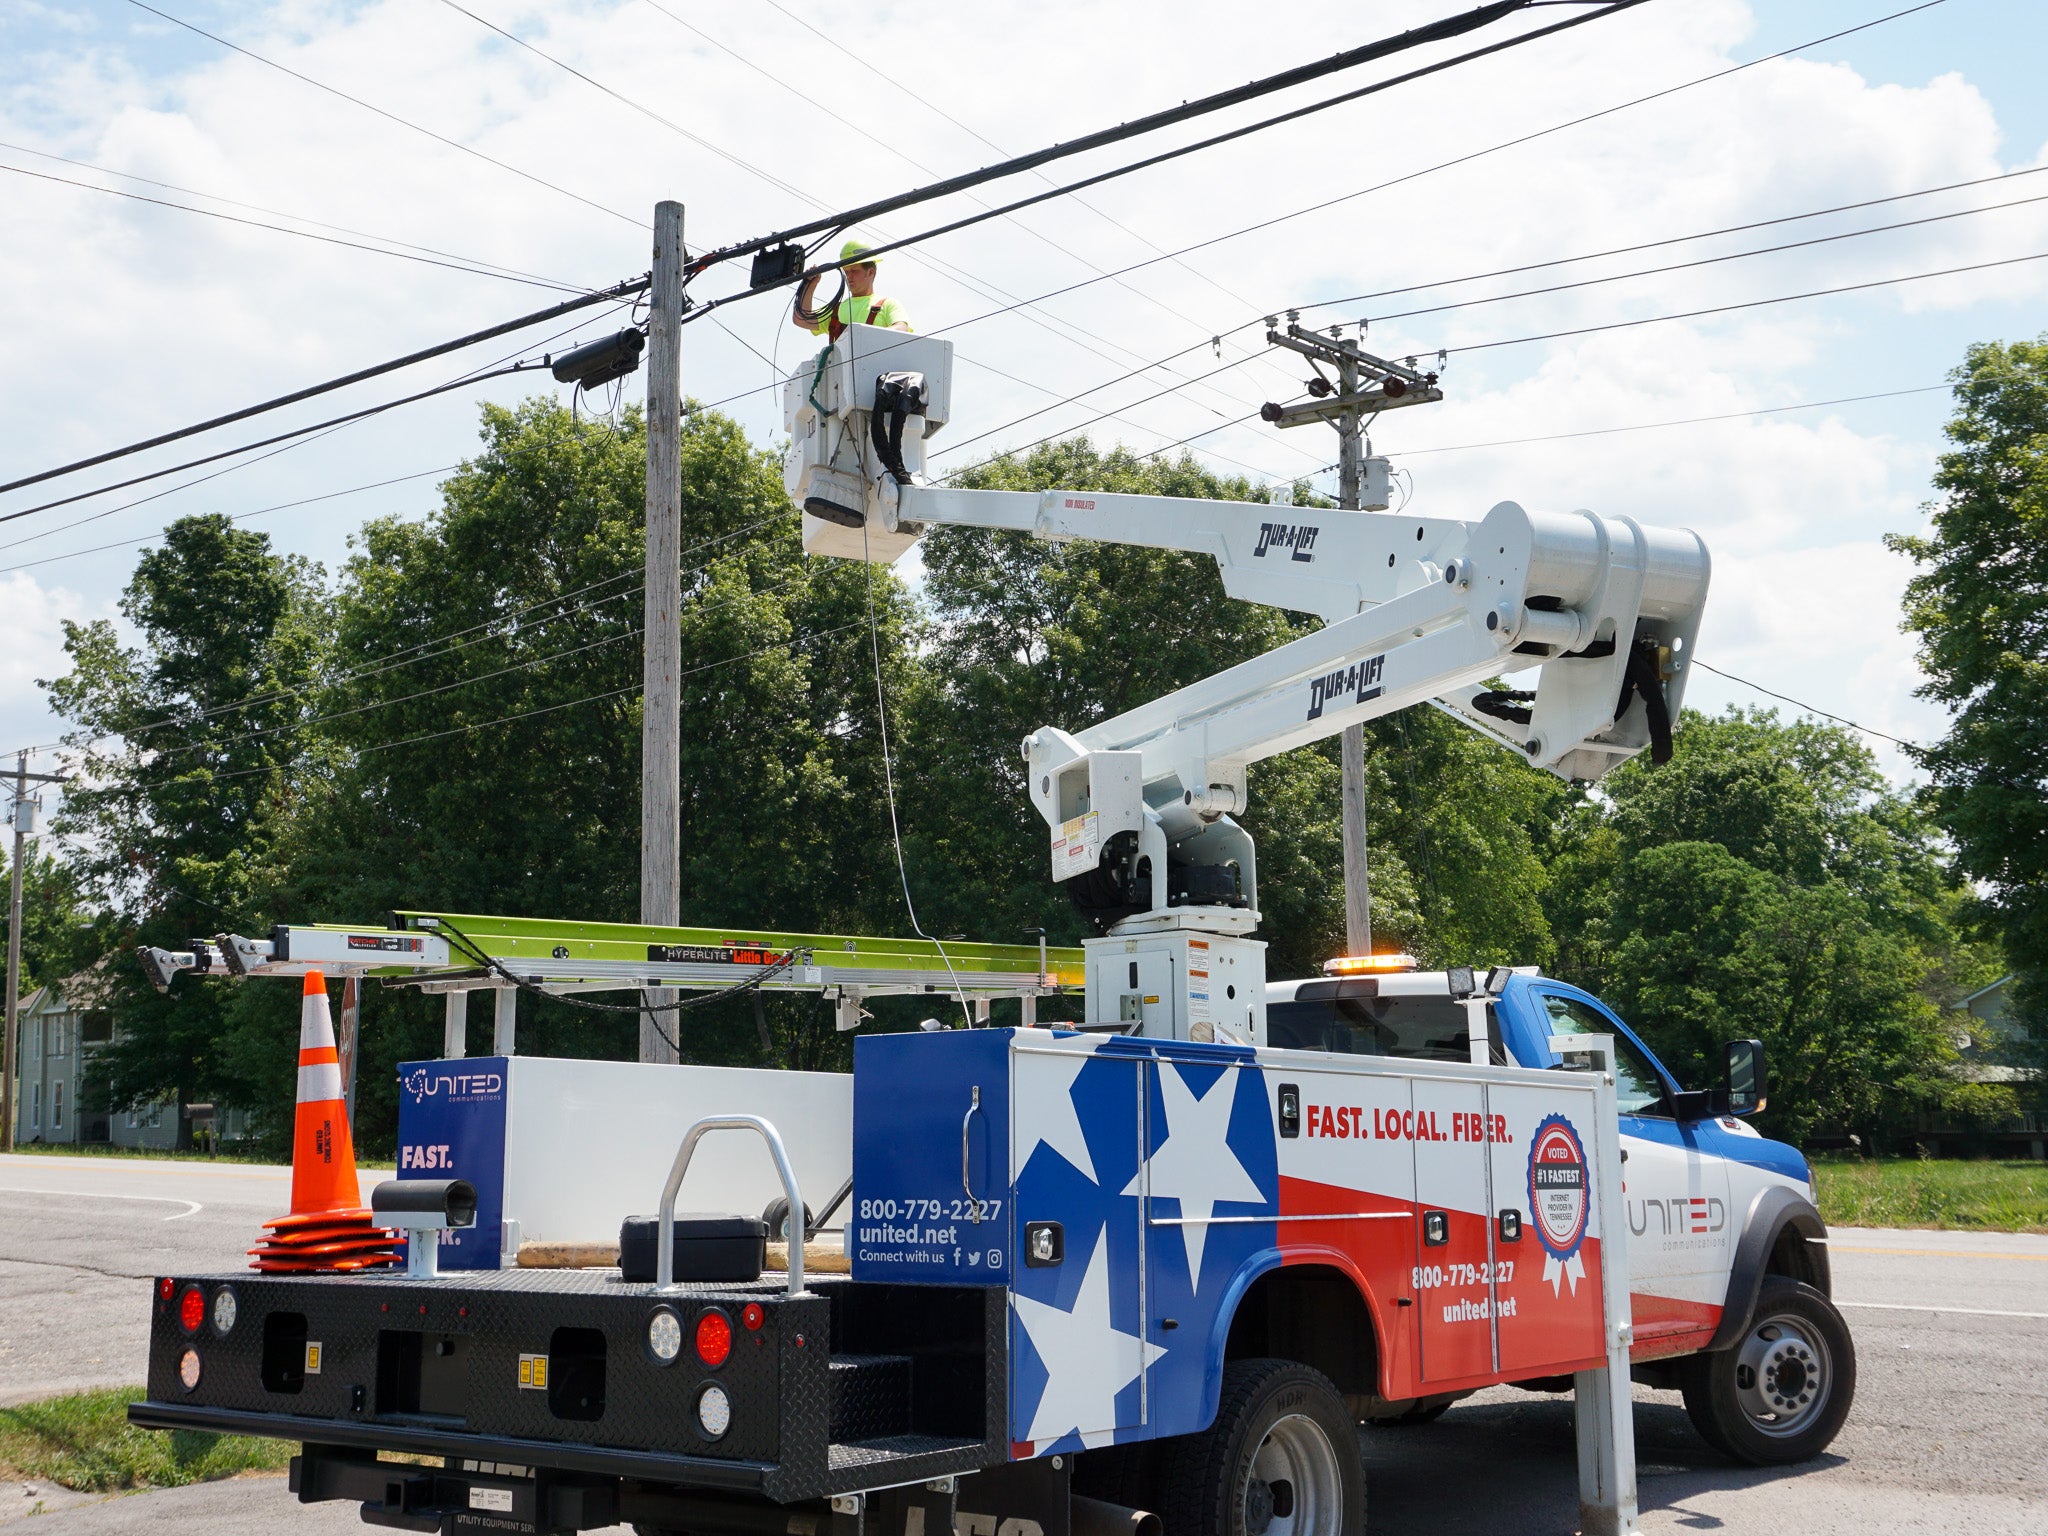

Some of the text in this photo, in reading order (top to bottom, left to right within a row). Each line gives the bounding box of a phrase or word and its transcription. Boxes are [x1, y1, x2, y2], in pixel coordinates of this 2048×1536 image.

[667, 949, 727, 960] HYPERLITE
[733, 949, 761, 964] Little
[424, 1074, 502, 1096] UNITED
[1307, 1105, 1513, 1143] FAST. LOCAL. FIBER.
[401, 1145, 453, 1169] FAST.
[1547, 1147, 1568, 1159] VOTED
[1537, 1168, 1580, 1184] #1 FASTEST
[1550, 1193, 1570, 1202] INTERNET
[860, 1199, 1002, 1221] 800-779-2227
[1547, 1203, 1568, 1212] PROVIDER
[1549, 1211, 1573, 1221] TENNESSEE
[1628, 1197, 1725, 1236] UNITED
[860, 1222, 957, 1244] united.net
[1662, 1237, 1727, 1251] communications
[859, 1249, 903, 1262] Connect
[905, 1250, 929, 1263] with
[932, 1253, 945, 1263] us
[1443, 1296, 1517, 1323] united.net
[457, 1514, 482, 1526] UTILITY
[482, 1517, 520, 1531] EQUIPMENT
